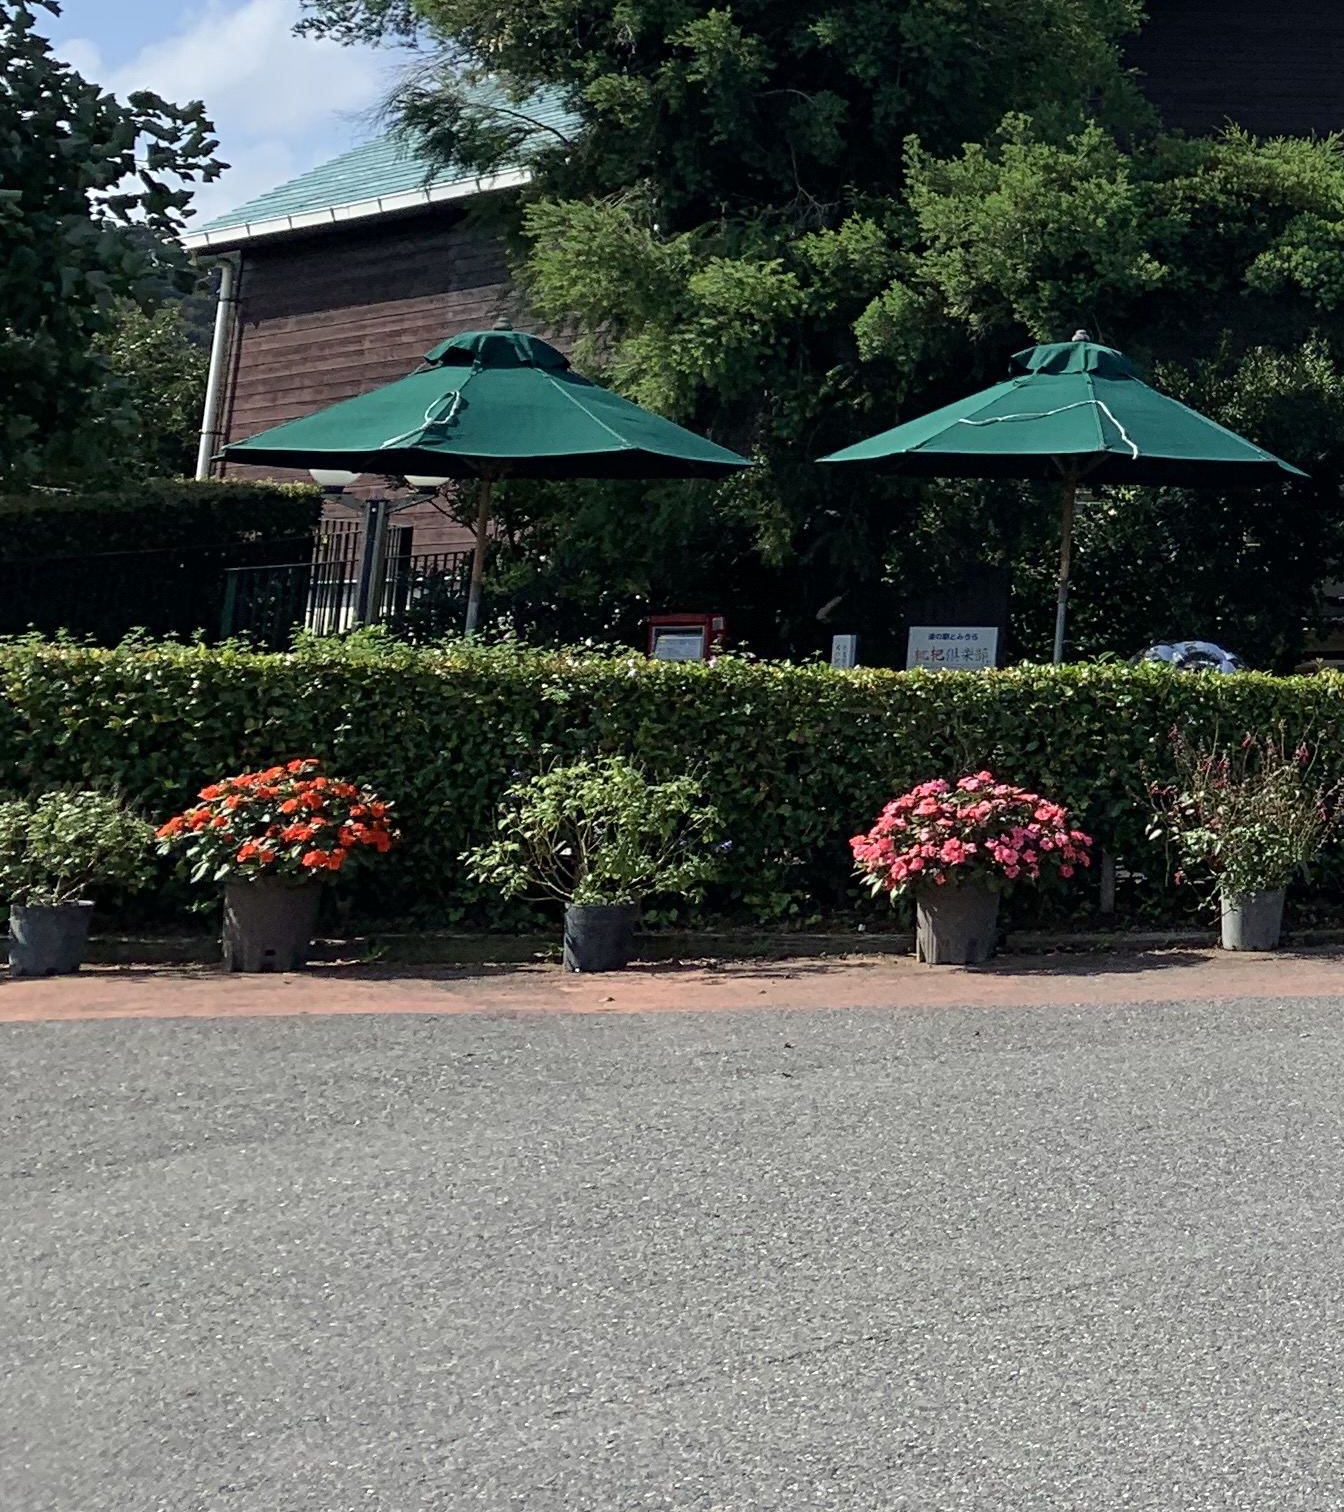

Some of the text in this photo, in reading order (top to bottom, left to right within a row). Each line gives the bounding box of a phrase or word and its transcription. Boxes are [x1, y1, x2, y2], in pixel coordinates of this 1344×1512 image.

[927, 632, 977, 641] 道の駅とみうら
